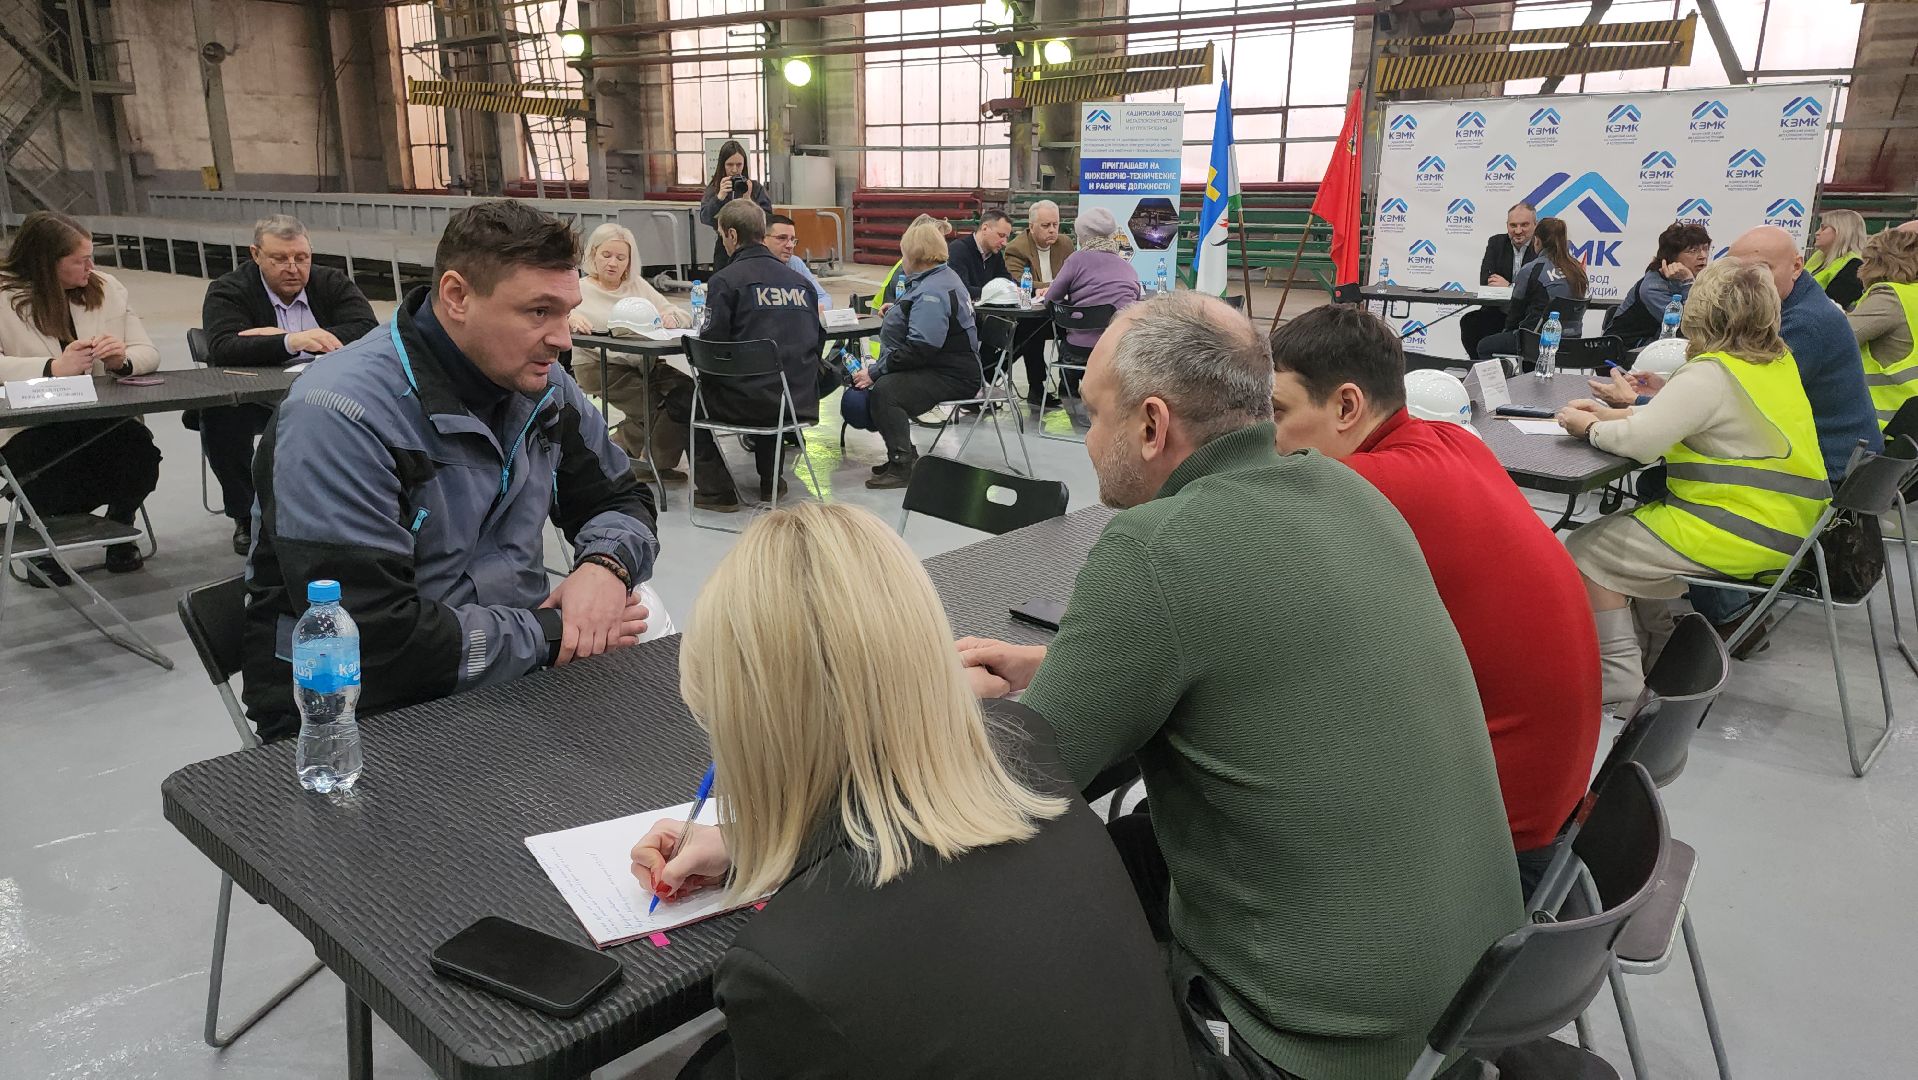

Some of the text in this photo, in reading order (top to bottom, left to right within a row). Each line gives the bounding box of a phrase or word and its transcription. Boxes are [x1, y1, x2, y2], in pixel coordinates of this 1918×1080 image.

[1690, 121, 1726, 130] КЗМК
[1780, 117, 1820, 128] КЗМК
[1527, 127, 1559, 136] КЗМК
[1605, 124, 1639, 133] КЗМК
[1388, 131, 1415, 140] КЗМК
[1455, 129, 1484, 138] КЗМК
[1101, 161, 1160, 170] ПРИГЛАШАЕМ НА
[1084, 172, 1177, 180] ИНЖЕНЕРНО-ТЕХНИЧЕСКИЕ
[1416, 173, 1444, 181] КЗМК
[1485, 172, 1515, 181] КЗМК
[1640, 170, 1674, 179] КЗМК
[1726, 169, 1764, 178] КЗМК
[1089, 182, 1171, 191] И РАБОЧИЕ ДОЛЖНОСТИ
[1380, 214, 1407, 223] КЗМК
[1446, 215, 1474, 224] КЗМК
[1568, 240, 1623, 266] МК
[1408, 256, 1435, 264] КЗМК
[1590, 275, 1609, 285] ВОД
[755, 287, 808, 307] КЗМК
